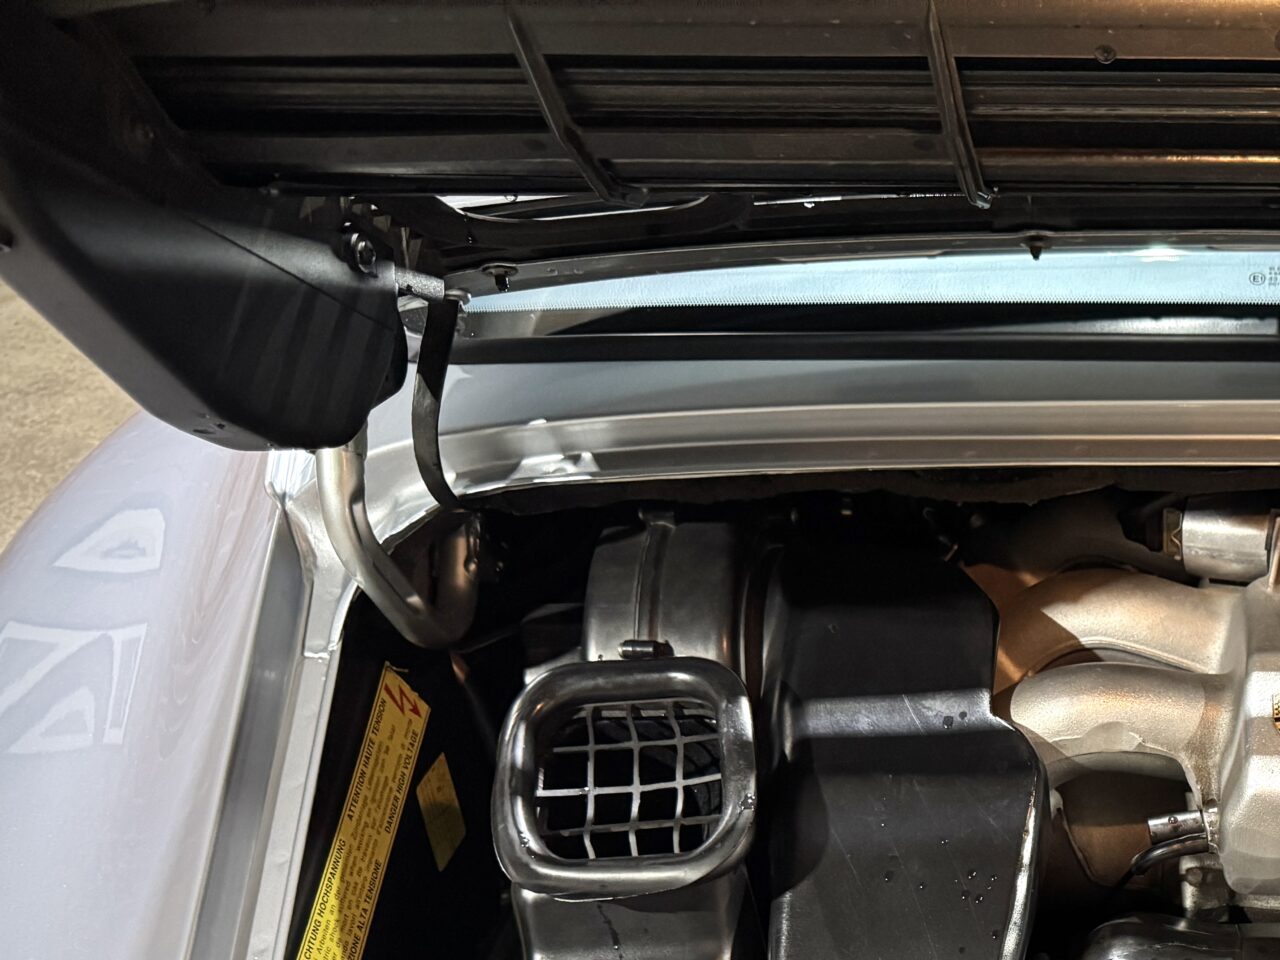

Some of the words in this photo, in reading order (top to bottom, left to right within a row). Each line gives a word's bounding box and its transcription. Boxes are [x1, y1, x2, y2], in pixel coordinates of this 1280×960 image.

[347, 769, 366, 821] ATTENTION
[362, 737, 375, 768] HAUTE
[371, 697, 386, 736] TENSION
[384, 794, 399, 833] DANGER
[395, 770, 406, 794] HIGH
[402, 729, 418, 769] VOLTAGE
[317, 838, 345, 917] HOCHSPANNUNG
[356, 907, 368, 932] ALTA
[363, 859, 381, 903] TENSIONE
[316, 919, 330, 954] Arbeiten
